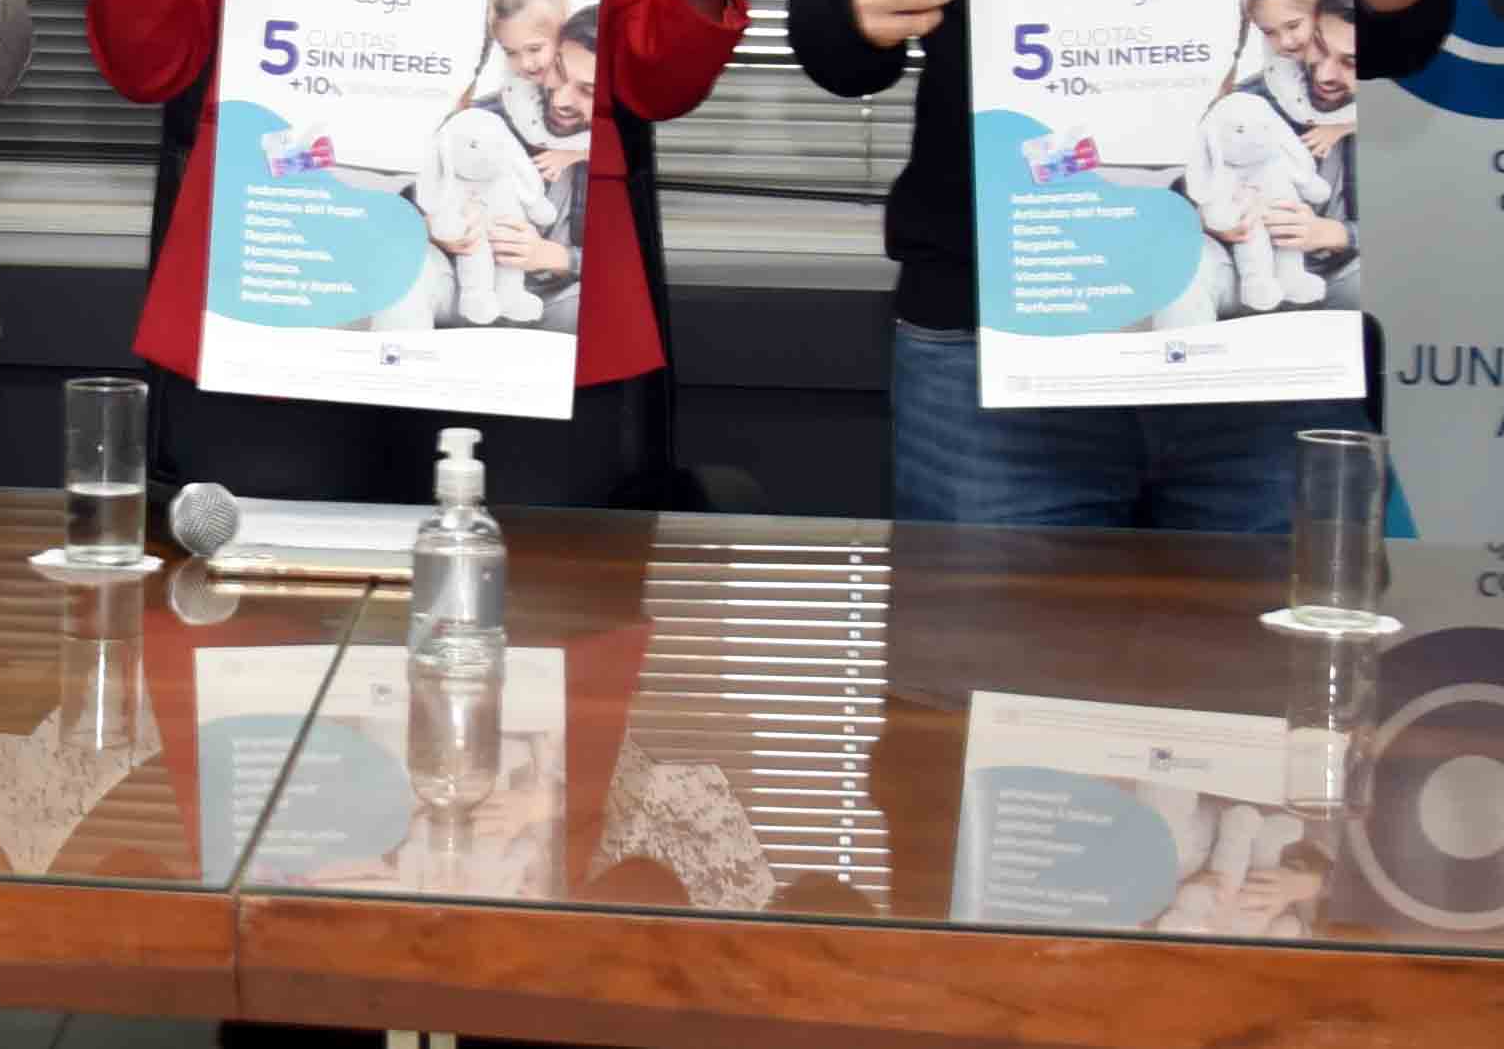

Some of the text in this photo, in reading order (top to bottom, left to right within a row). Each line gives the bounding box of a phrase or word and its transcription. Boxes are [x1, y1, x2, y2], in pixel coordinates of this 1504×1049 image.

[259, 19, 301, 76] 5
[306, 45, 453, 75] SIN INTERÉS
[1011, 23, 1053, 80] 5
[1060, 38, 1211, 67] SIN INTERÉS
